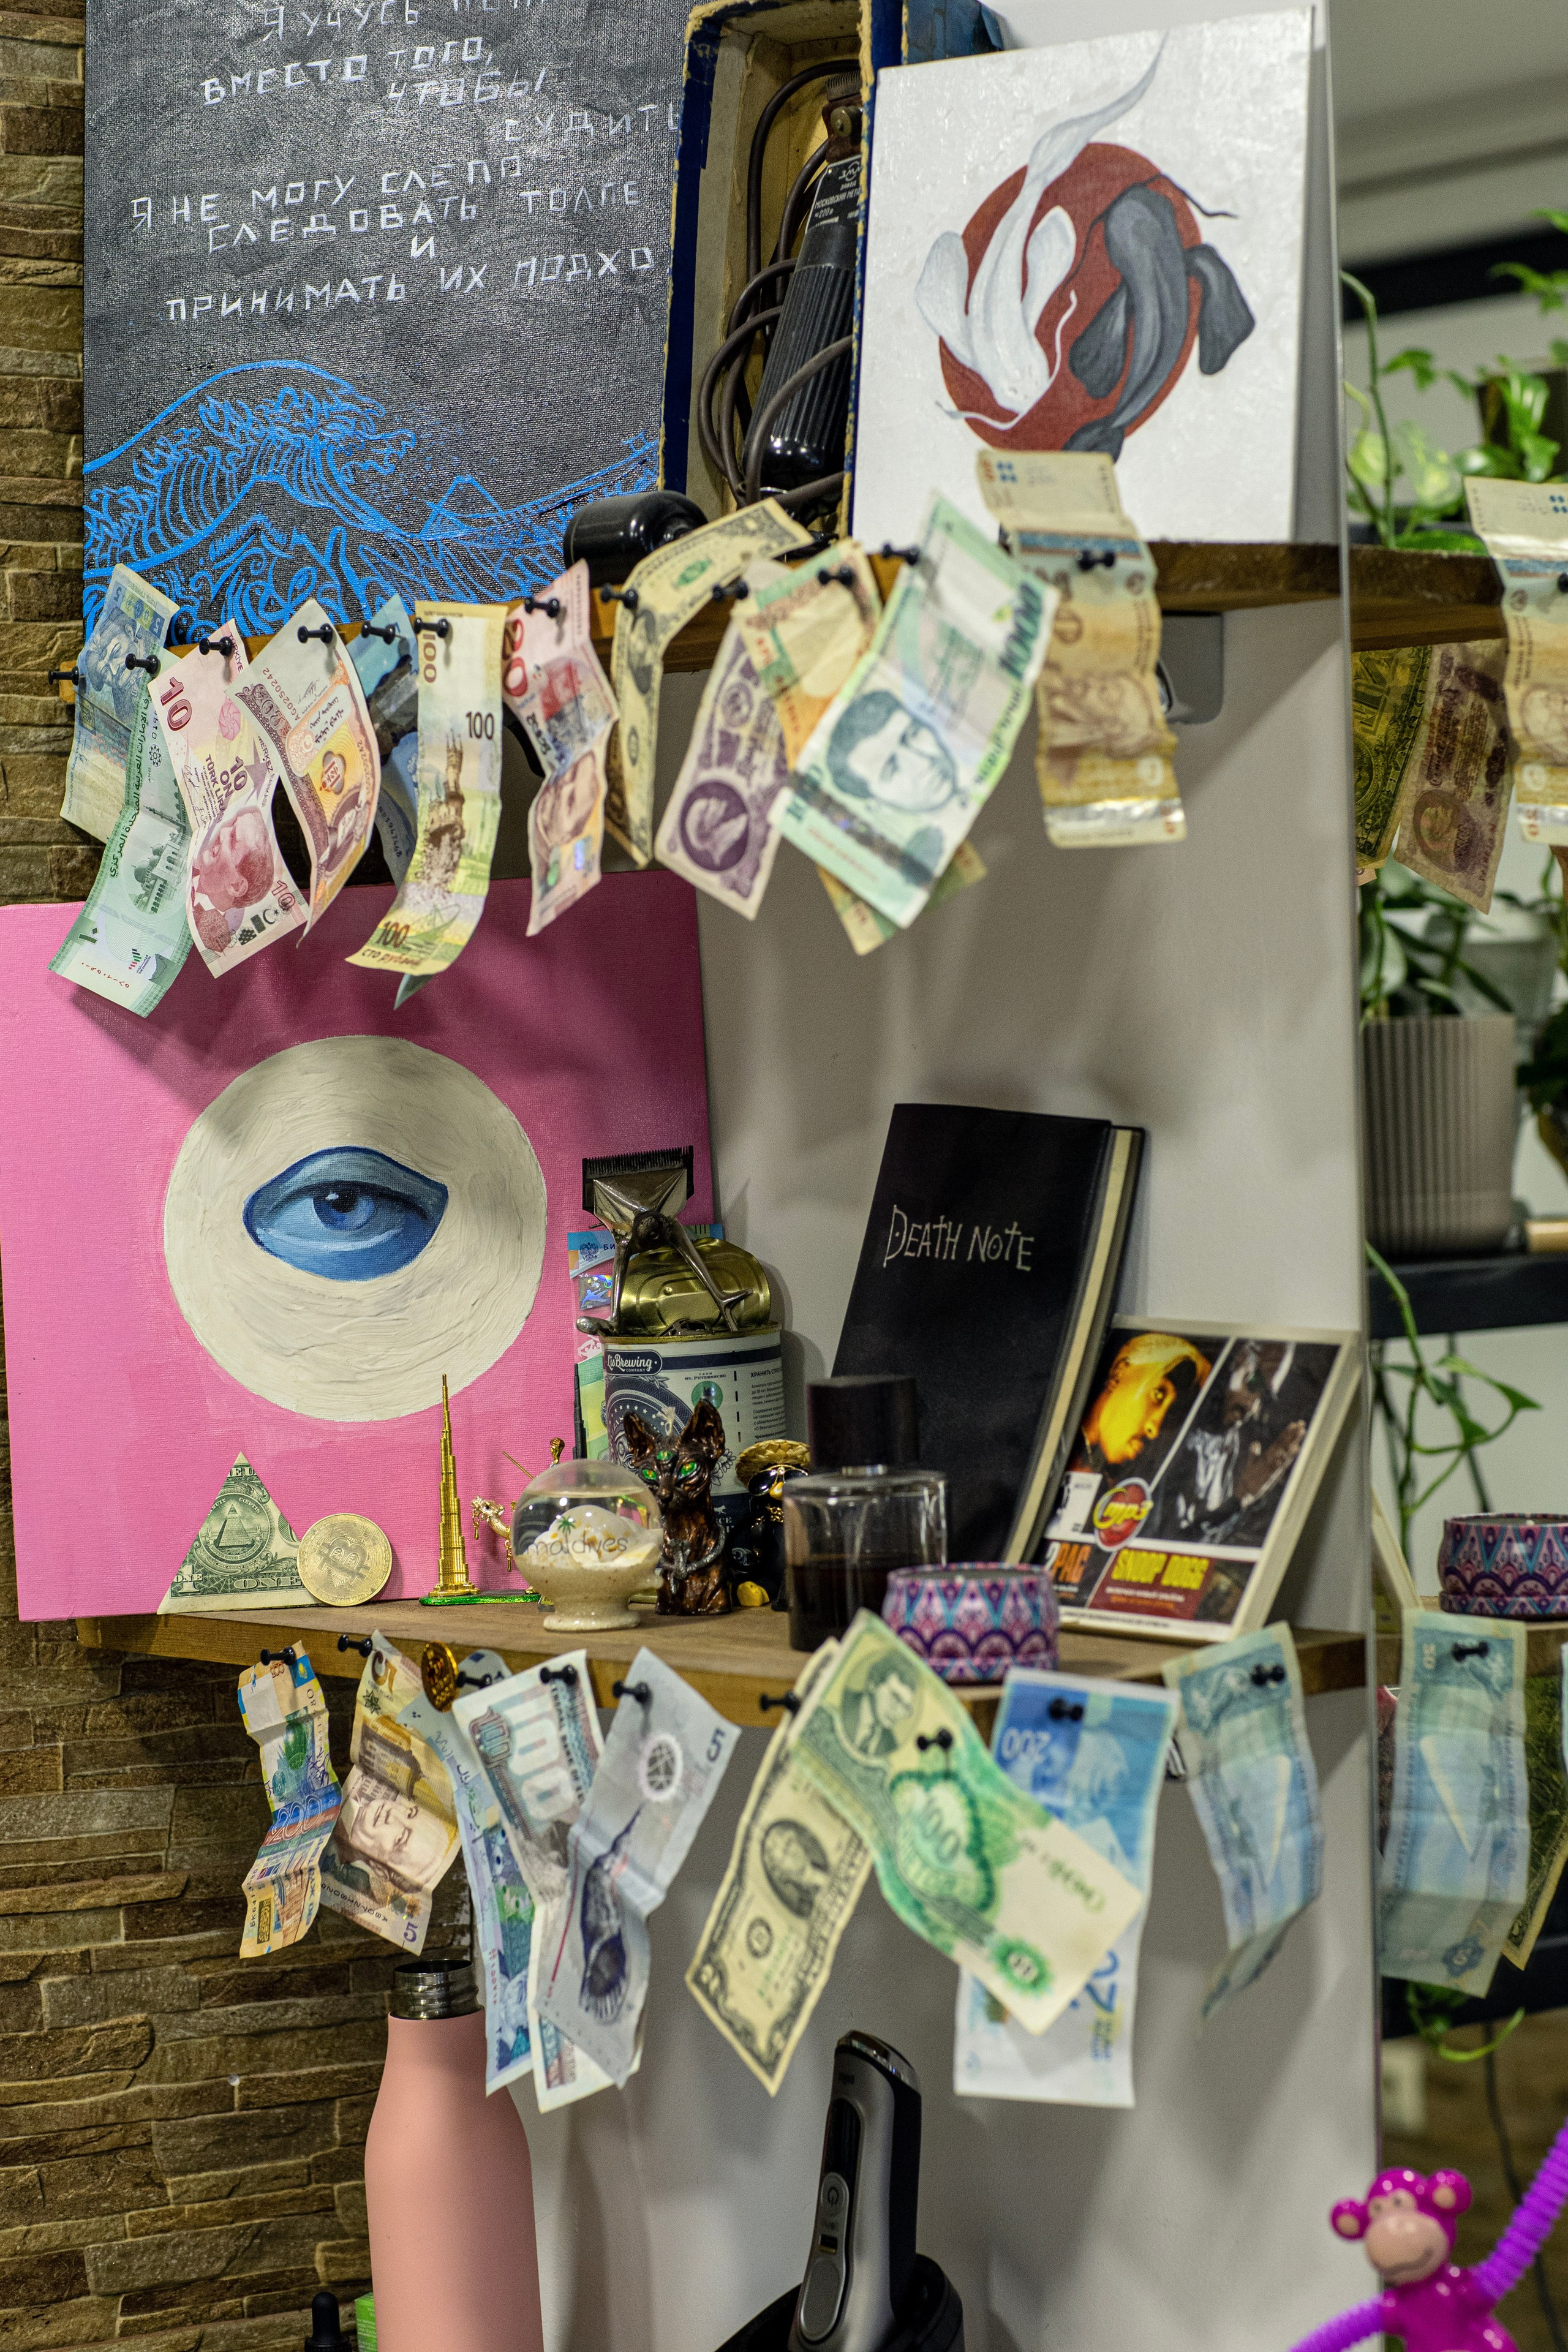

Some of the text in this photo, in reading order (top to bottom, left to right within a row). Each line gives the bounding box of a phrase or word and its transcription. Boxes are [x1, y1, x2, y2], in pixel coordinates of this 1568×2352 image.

[262, 1, 419, 42] Я УЧУСЬ
[199, 36, 493, 107] ВМЕСТО ТОГО,
[388, 67, 546, 111] ЧТОБЫ
[130, 155, 521, 232] Я НЕ МОГУ СЛЕПО
[209, 181, 641, 254] СЛЕДОВАТЬ ТОЛПЕ
[410, 235, 435, 259] И
[167, 246, 655, 322] ПРИНИМАТЬ ИХ ПОДХО
[153, 617, 162, 634] 5
[422, 633, 437, 684] 100
[160, 676, 193, 732] 10
[262, 667, 301, 721] AG0250242
[466, 710, 496, 741] 100
[205, 753, 219, 789] TÜRK
[219, 769, 235, 799] ON
[230, 755, 249, 792] 10
[271, 880, 296, 911] 10
[375, 921, 411, 949] 100
[883, 1204, 1035, 1272] DEATH NOTE
[606, 1353, 653, 1372] LisBrewing
[750, 1369, 771, 1378] ХРАНИТЬ
[527, 1531, 629, 1556] maldives
[173, 1573, 203, 1583] ONE
[233, 1575, 302, 1591] ONE
[706, 1727, 726, 1763] 5
[267, 1793, 323, 1846] 200
[403, 1921, 419, 1943] 5
